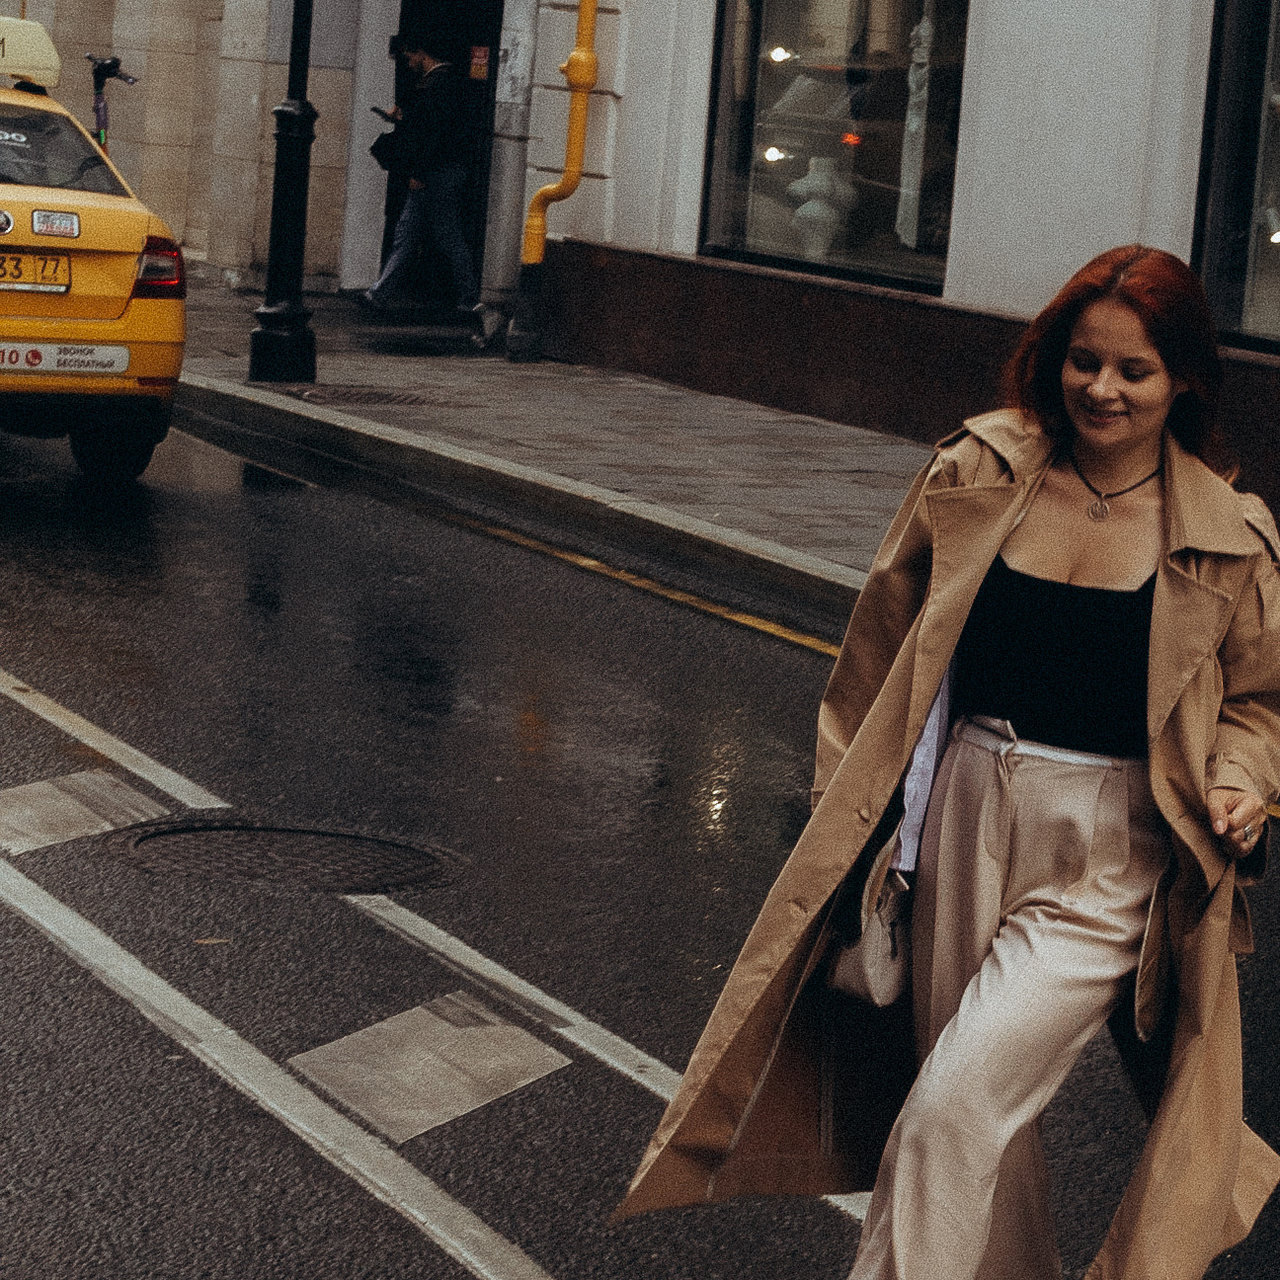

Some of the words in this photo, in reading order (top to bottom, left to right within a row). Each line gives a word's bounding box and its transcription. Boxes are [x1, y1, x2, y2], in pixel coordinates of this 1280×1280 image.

[38, 257, 60, 276] 77
[57, 346, 95, 356] ЗВОНОК
[56, 358, 115, 369] БЕСПЛАТНЫЙ
